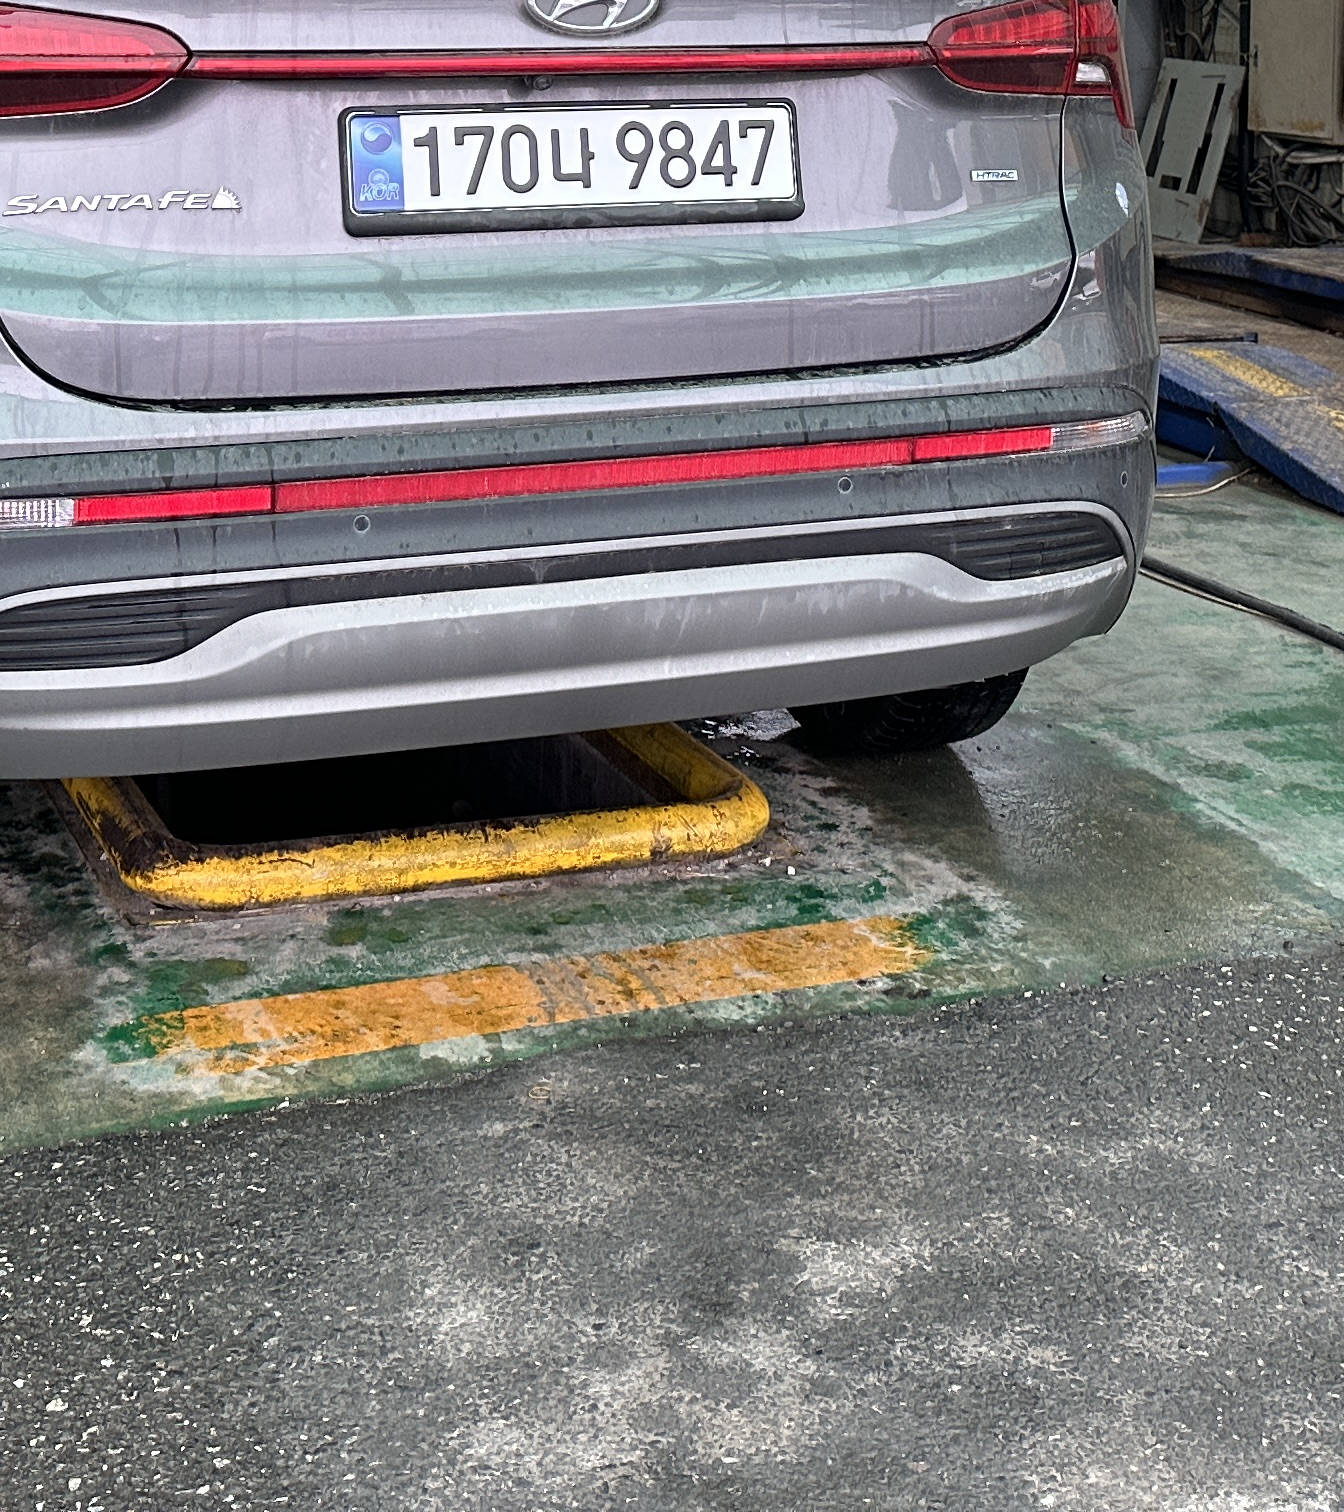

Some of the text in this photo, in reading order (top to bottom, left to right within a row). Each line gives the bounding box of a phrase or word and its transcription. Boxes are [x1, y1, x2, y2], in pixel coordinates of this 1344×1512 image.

[615, 119, 775, 190] 9847
[976, 171, 1015, 180] HTRAC
[359, 181, 400, 202] KOR
